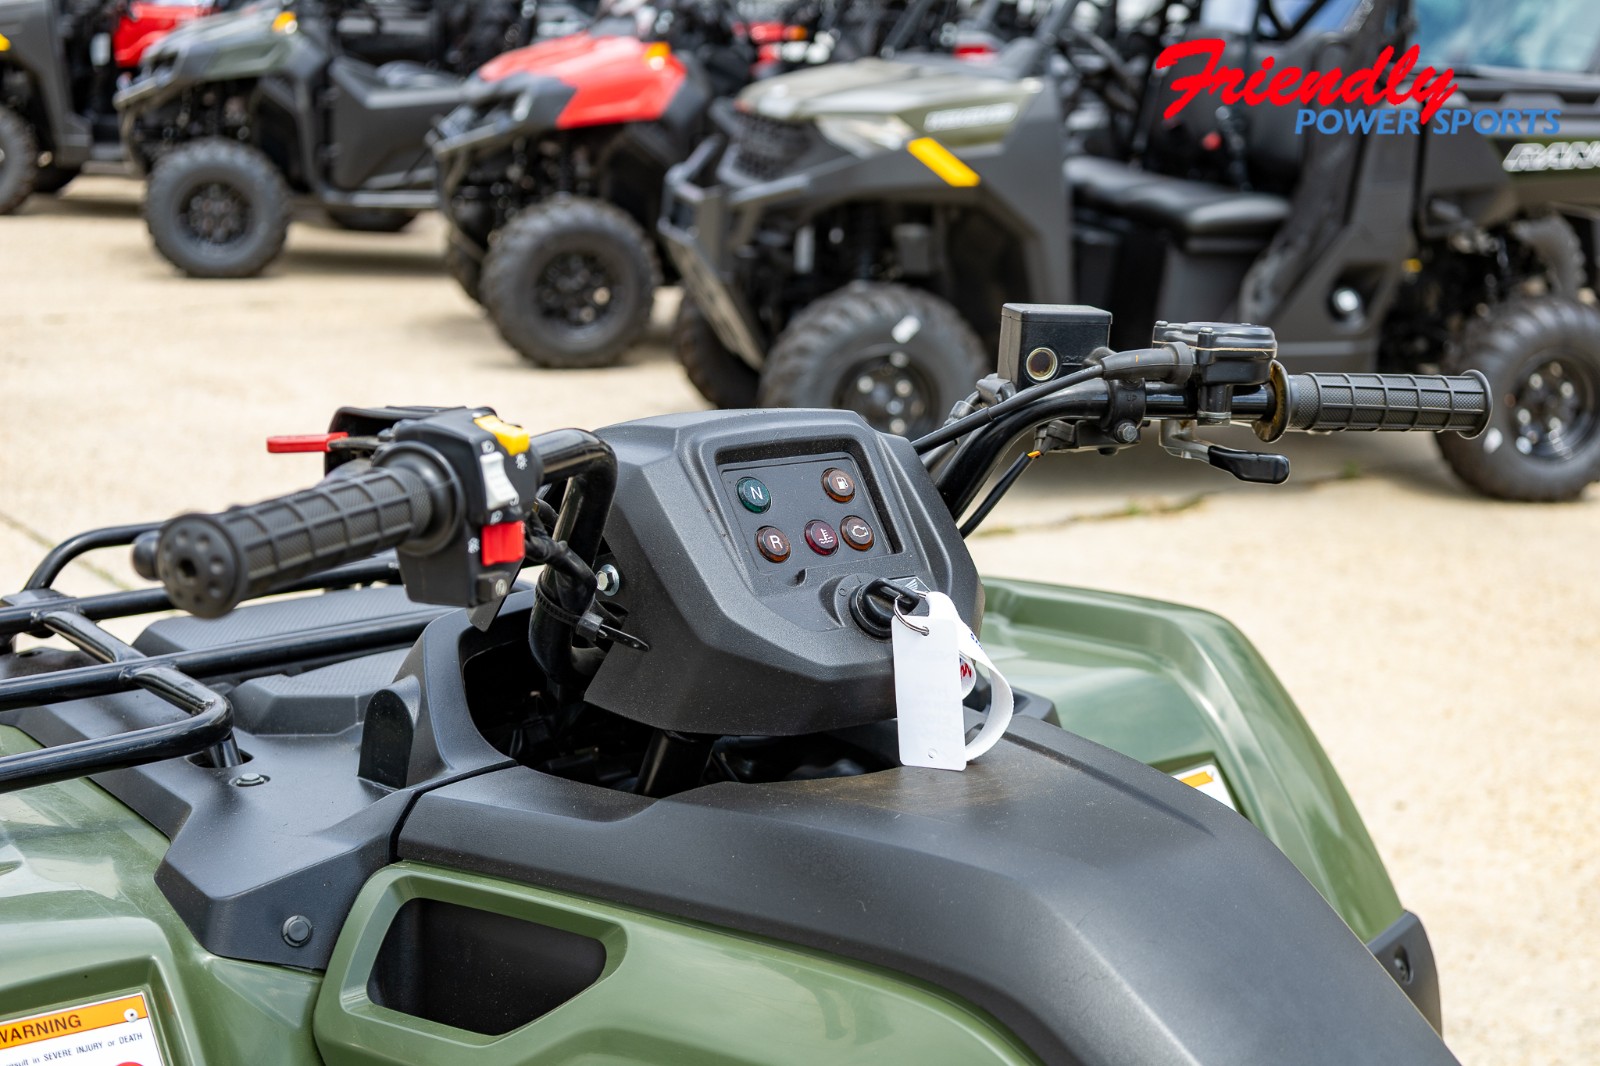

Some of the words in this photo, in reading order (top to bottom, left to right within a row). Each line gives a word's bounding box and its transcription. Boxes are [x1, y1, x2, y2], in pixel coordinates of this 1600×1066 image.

[750, 486, 764, 499] N
[769, 535, 783, 549] R
[43, 1048, 72, 1062] SEVERE
[76, 1041, 103, 1054] INJURY
[118, 1032, 143, 1045] DEATH
